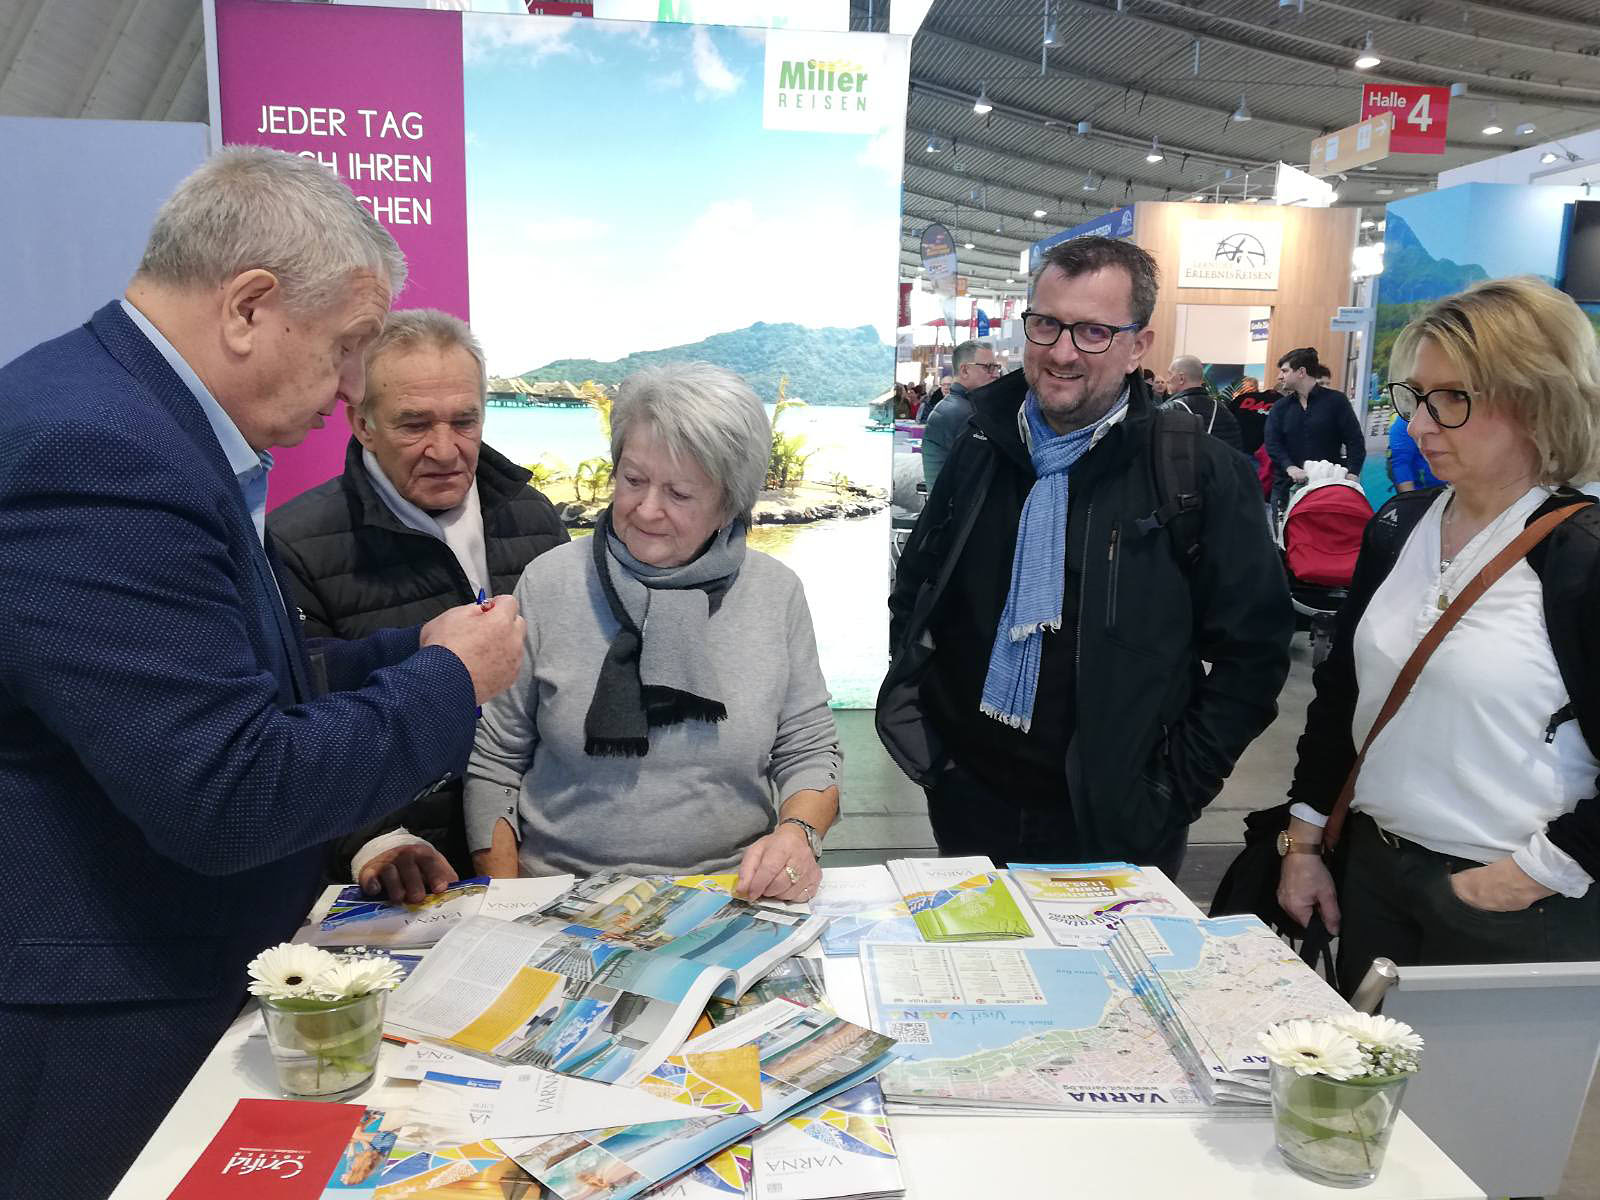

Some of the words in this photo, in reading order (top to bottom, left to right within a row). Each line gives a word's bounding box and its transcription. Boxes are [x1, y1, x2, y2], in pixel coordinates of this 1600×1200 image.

[779, 59, 868, 92] Miller
[779, 93, 866, 111] REISEN
[1369, 91, 1407, 108] Halle
[1407, 94, 1433, 132] 4
[257, 105, 347, 137] JEDER
[357, 109, 423, 140] TAG
[349, 152, 432, 183] IHREN
[488, 902, 539, 910] VARNA
[971, 1011, 1006, 1024] Visit
[1242, 1055, 1267, 1065] AP
[535, 1073, 559, 1113] VARNA
[1068, 1092, 1168, 1104] VARNA
[234, 1152, 305, 1160] HOTELS
[766, 1154, 844, 1173] VARNA
